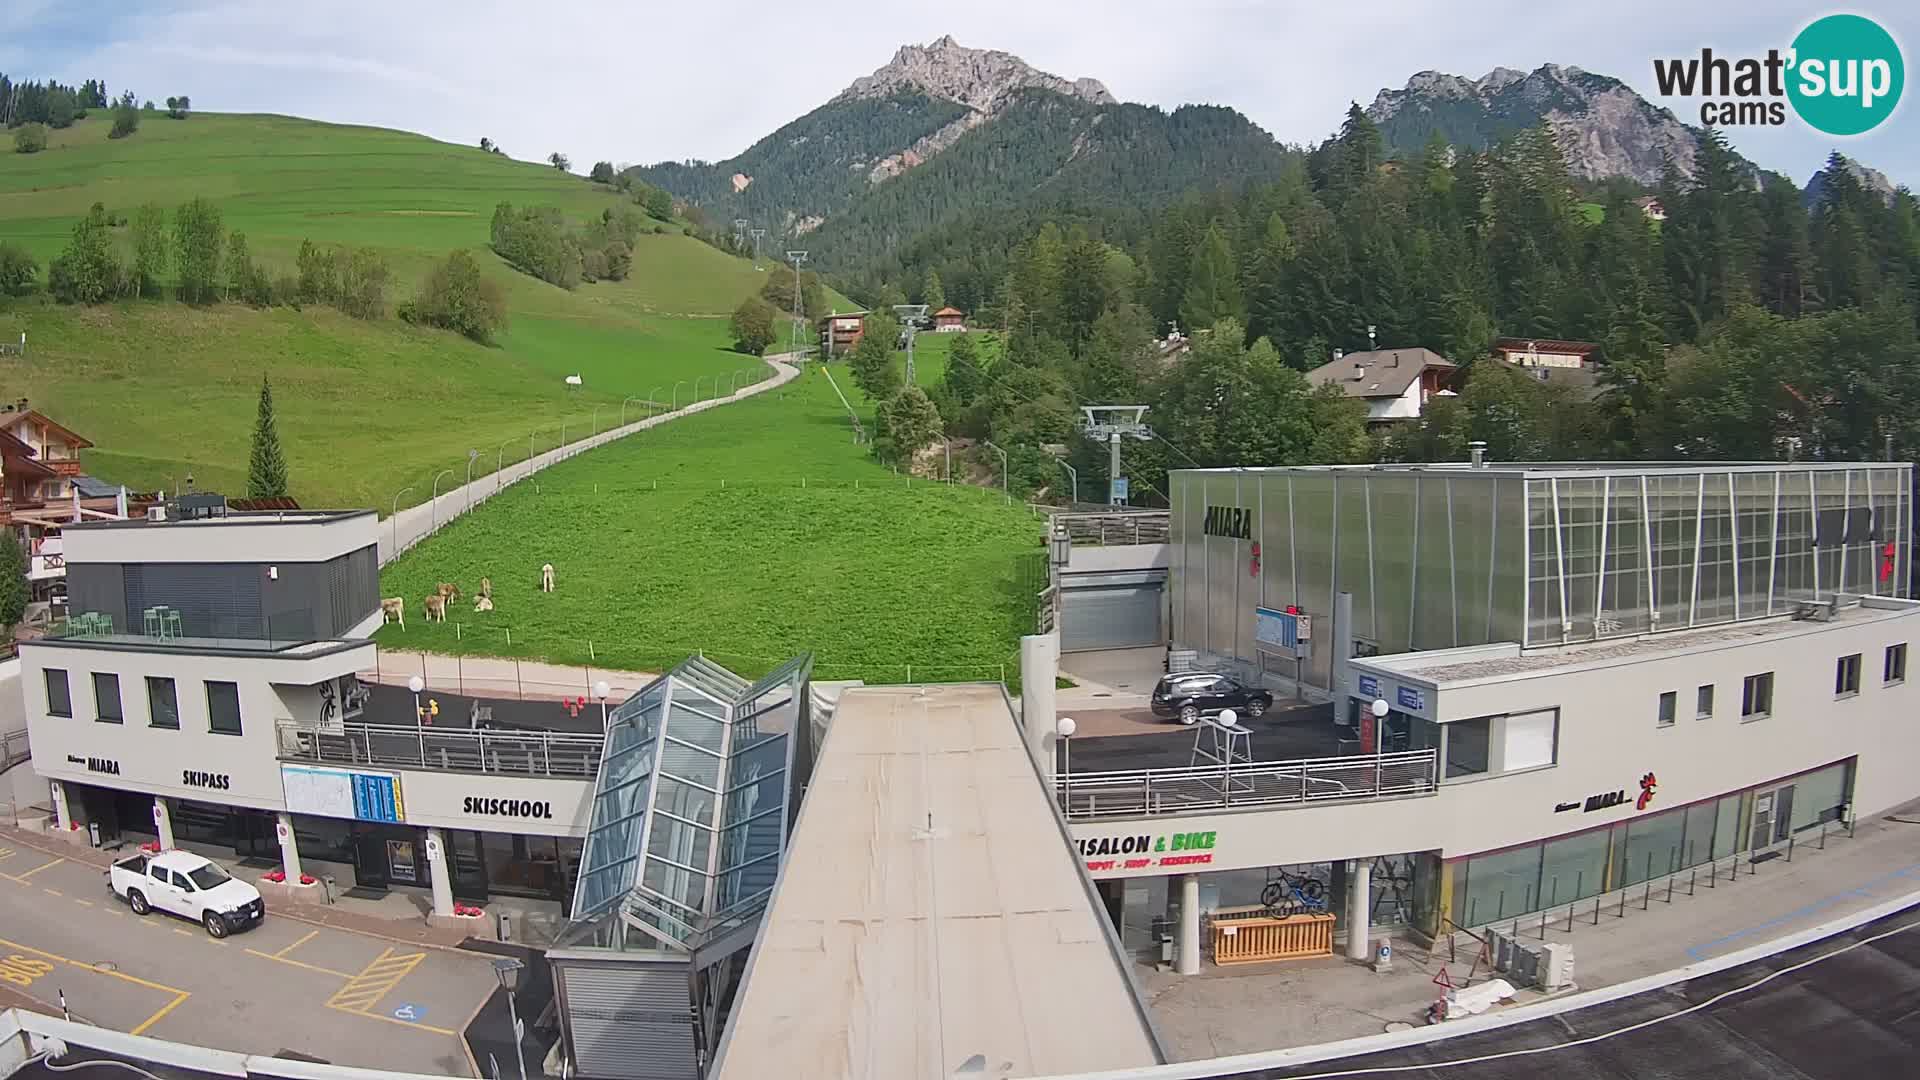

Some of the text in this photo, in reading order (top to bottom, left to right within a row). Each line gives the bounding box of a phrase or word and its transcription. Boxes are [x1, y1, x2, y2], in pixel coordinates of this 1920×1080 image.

[1204, 506, 1251, 539] MIARA
[88, 757, 120, 775] MIARA
[183, 770, 229, 789] SKIPASS
[463, 796, 552, 819] SKISCHOOL
[1584, 790, 1624, 812] MIARA
[1074, 831, 1216, 856] ISALON & BIKE
